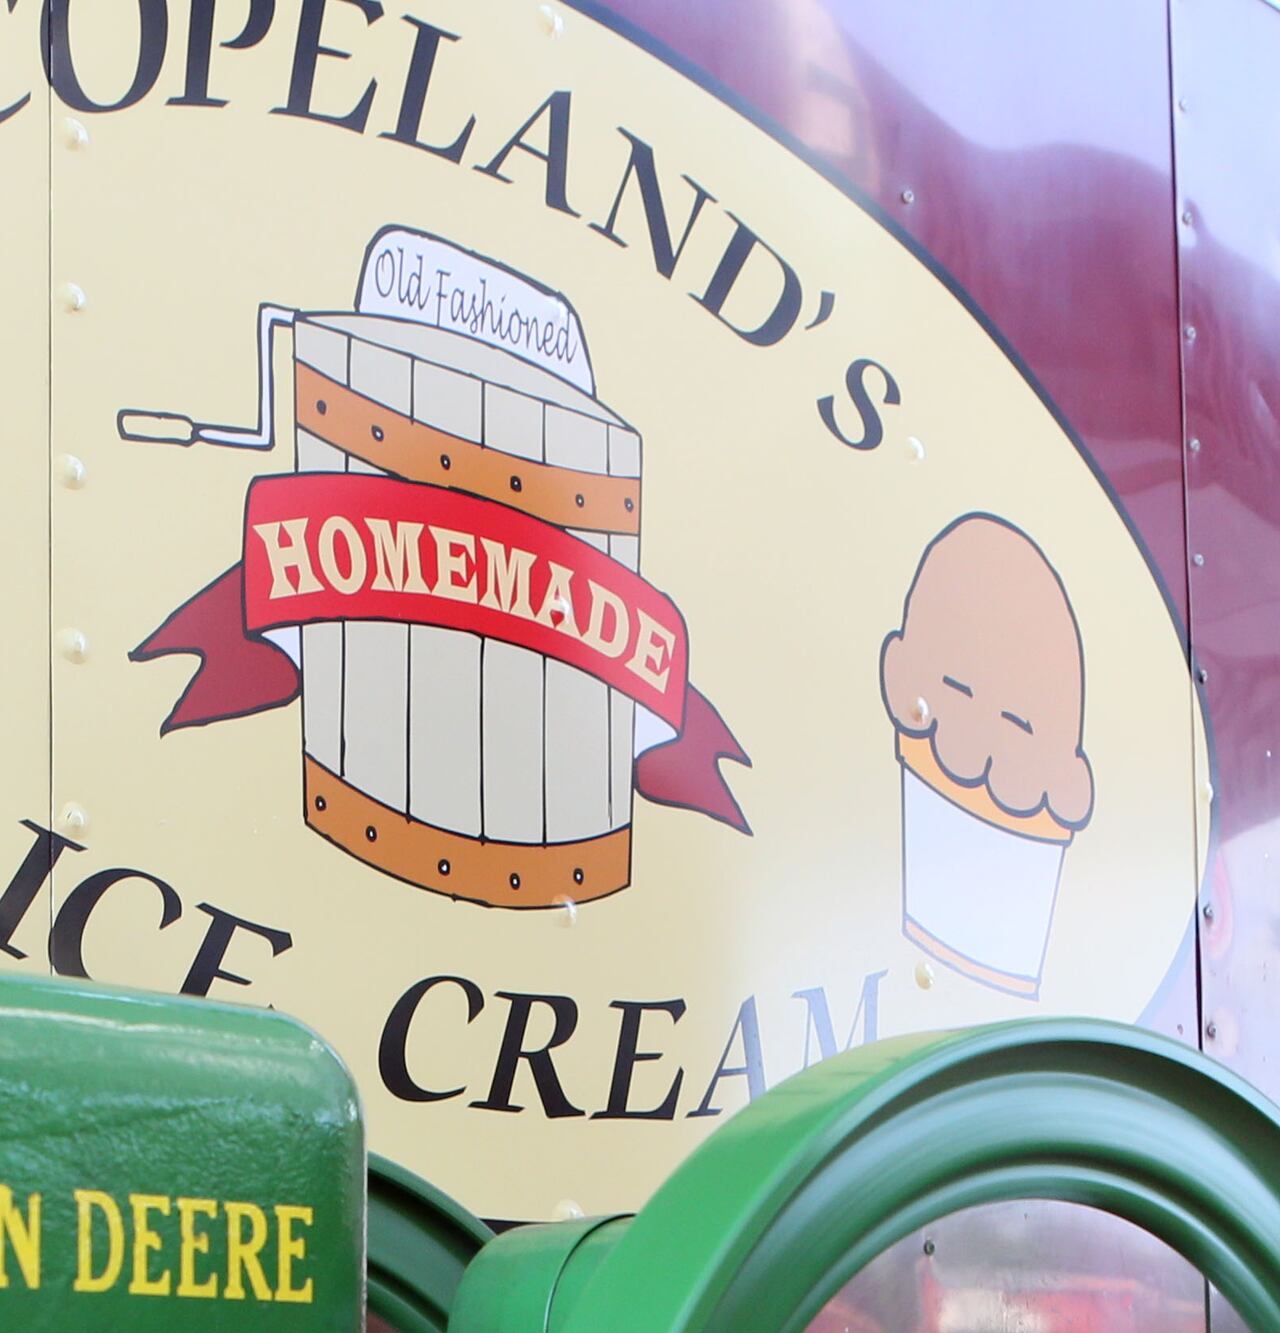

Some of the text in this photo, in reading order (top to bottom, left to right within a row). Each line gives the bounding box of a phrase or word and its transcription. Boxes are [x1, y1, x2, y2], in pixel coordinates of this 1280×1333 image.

[375, 246, 578, 363] Old Fashioned
[252, 515, 677, 694] HOMEMADE
[376, 969, 890, 1121] CREAM
[73, 1188, 314, 1304] DEERE
